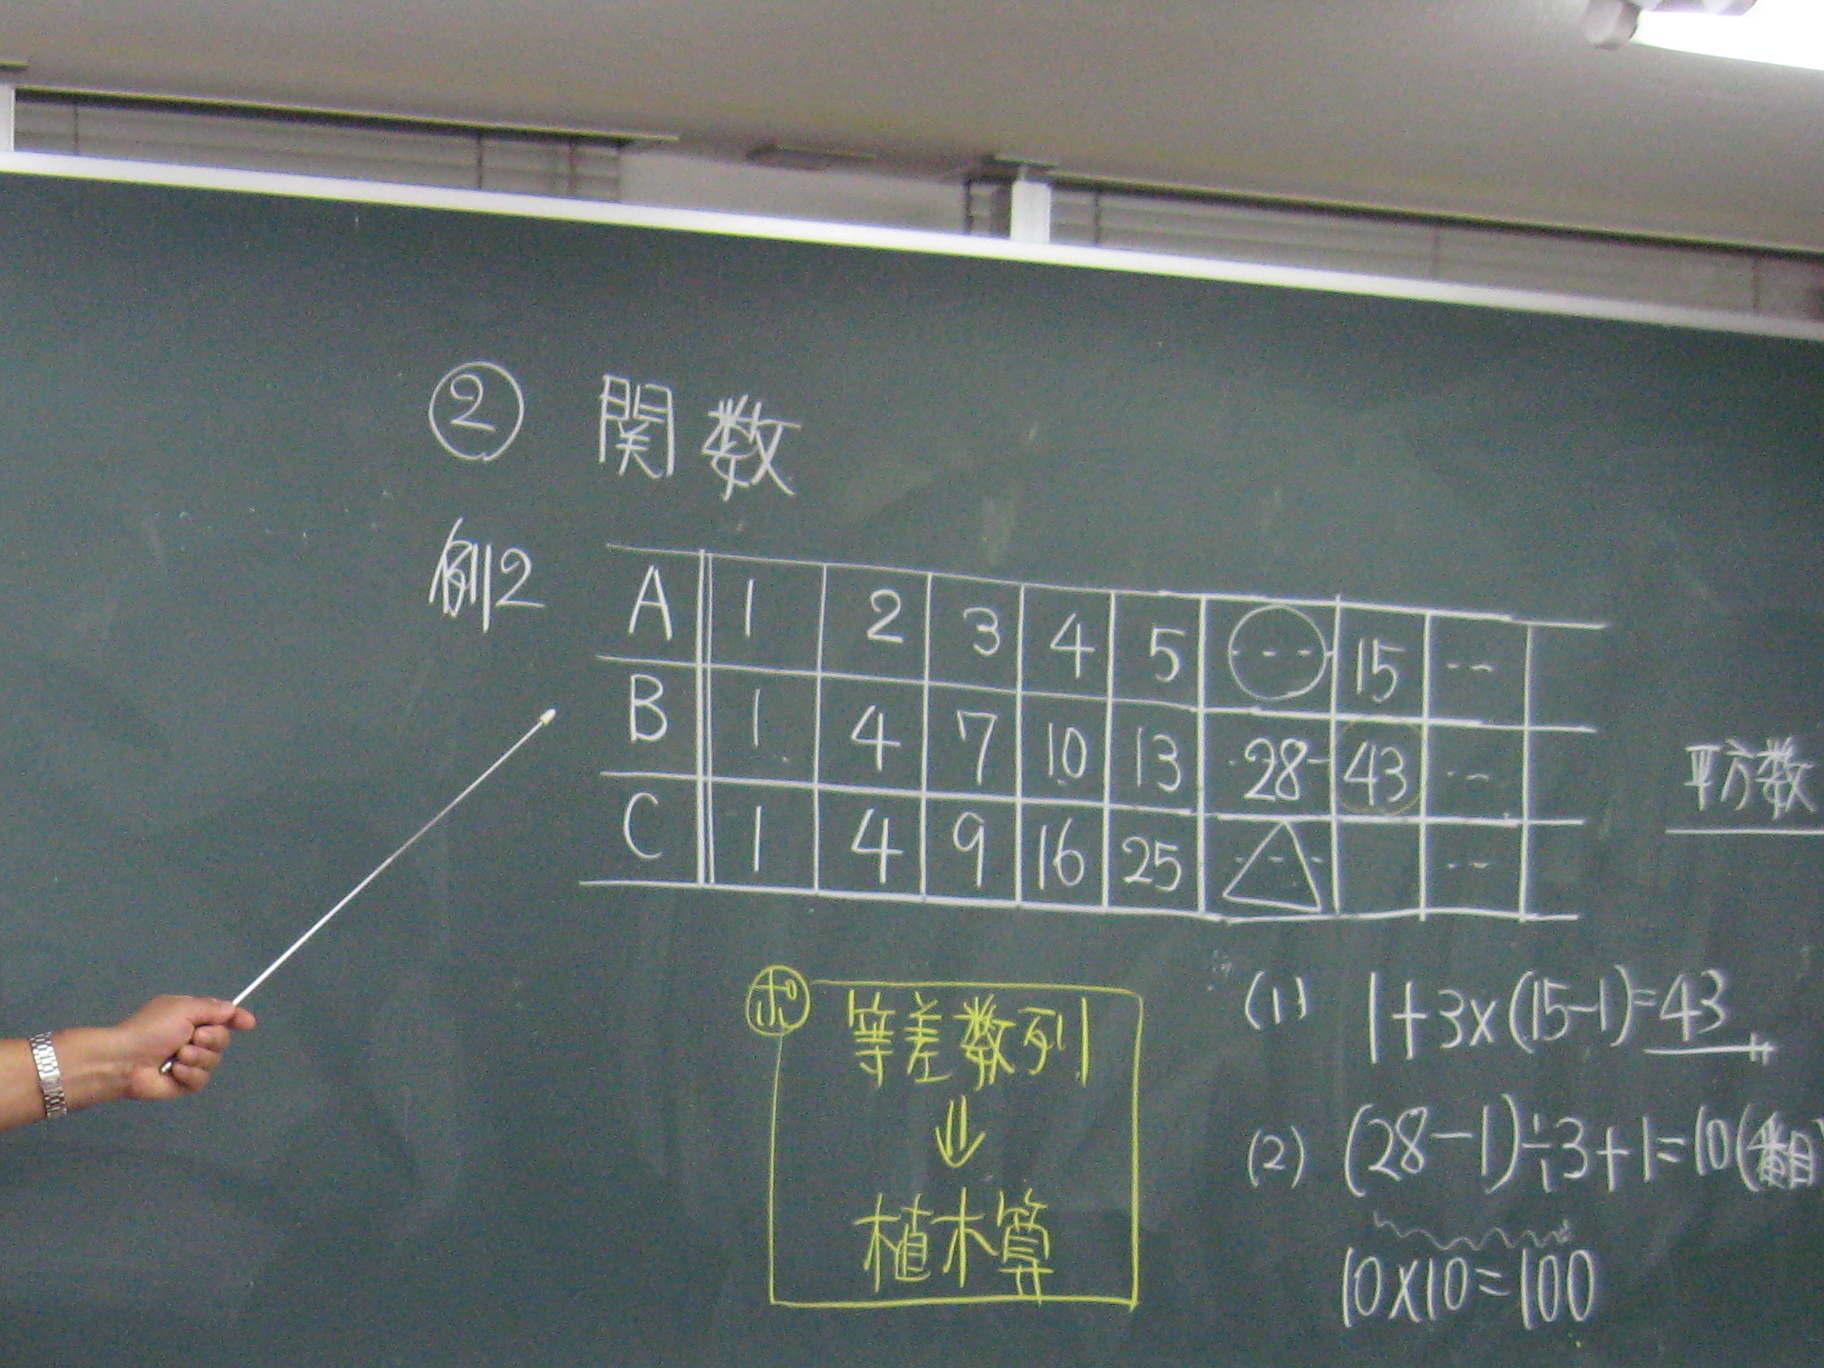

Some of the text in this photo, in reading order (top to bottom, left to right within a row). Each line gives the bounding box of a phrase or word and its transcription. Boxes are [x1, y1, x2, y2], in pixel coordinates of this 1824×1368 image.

[599, 373, 800, 501] 関数
[629, 565, 1400, 702] A 1 2 3 4 5 15
[630, 674, 668, 741] B
[851, 705, 901, 770] 4
[957, 710, 998, 784] 7
[1049, 724, 1088, 778] 10
[1137, 728, 1182, 792] 13
[1343, 745, 1408, 808] 43
[623, 791, 1182, 891] C 1 4 9 16 25
[848, 988, 1090, 1089] 等差数列
[1245, 971, 1309, 1029] (1)
[1248, 1126, 1306, 1186] (2)
[853, 1187, 1056, 1302] 植木算
